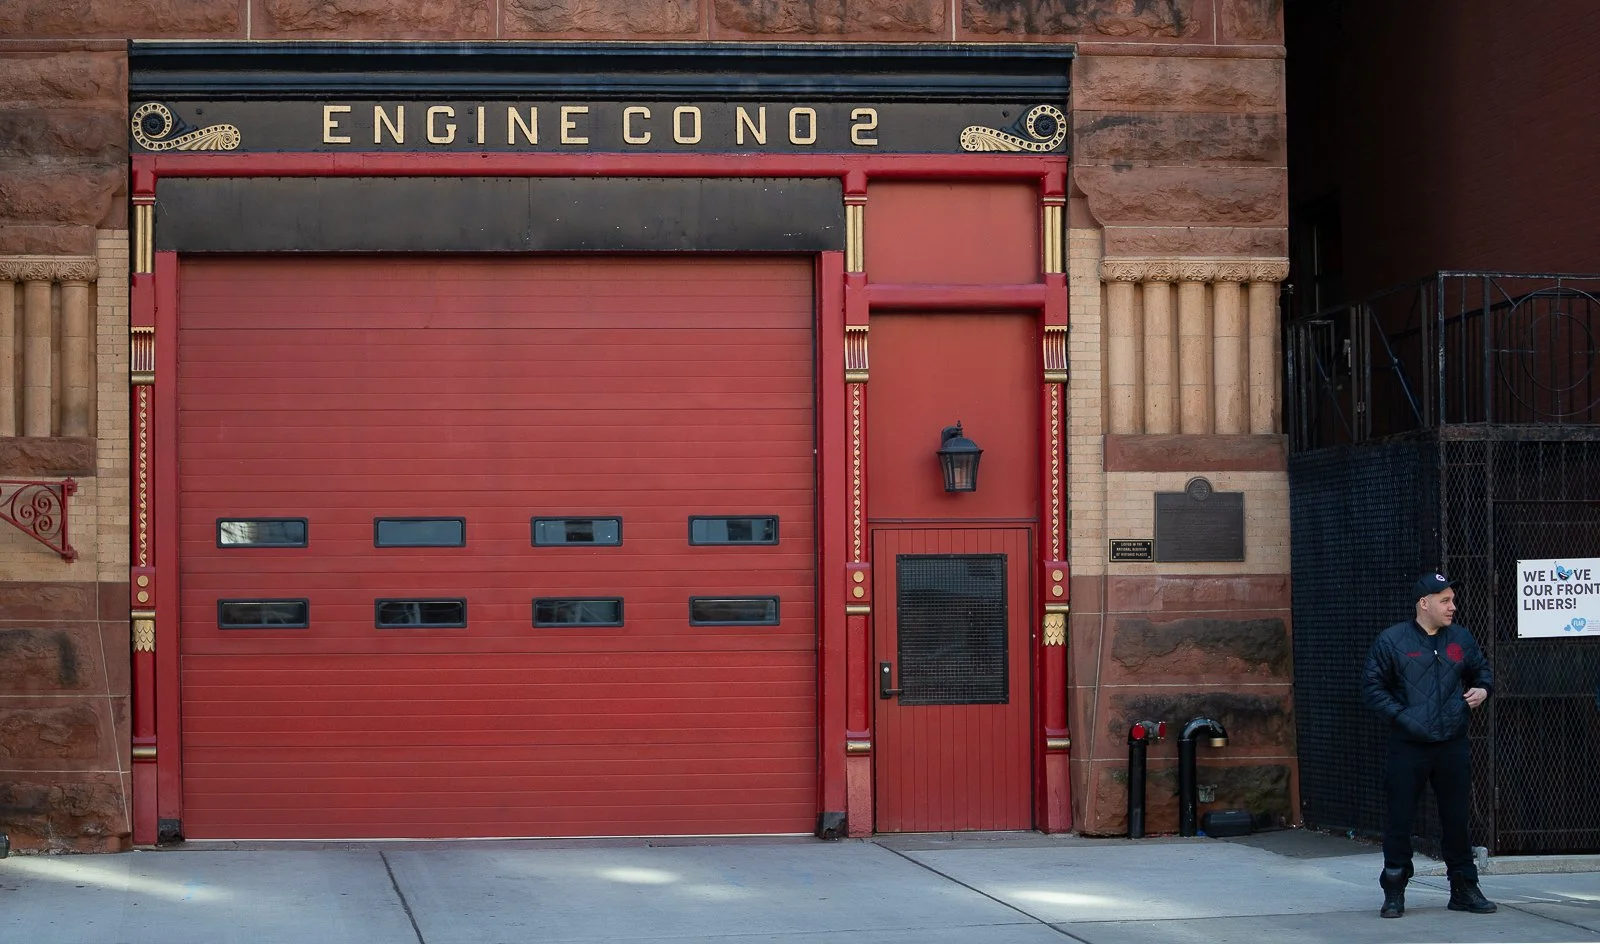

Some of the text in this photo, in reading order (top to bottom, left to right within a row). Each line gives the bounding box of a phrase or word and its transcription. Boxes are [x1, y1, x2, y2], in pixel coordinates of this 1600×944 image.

[322, 104, 878, 146] ENGINE CO NO 2
[1523, 567, 1592, 583] WE LVE
[1523, 583, 1600, 597] OUR FRONT
[1523, 598, 1577, 611] LINERS!
